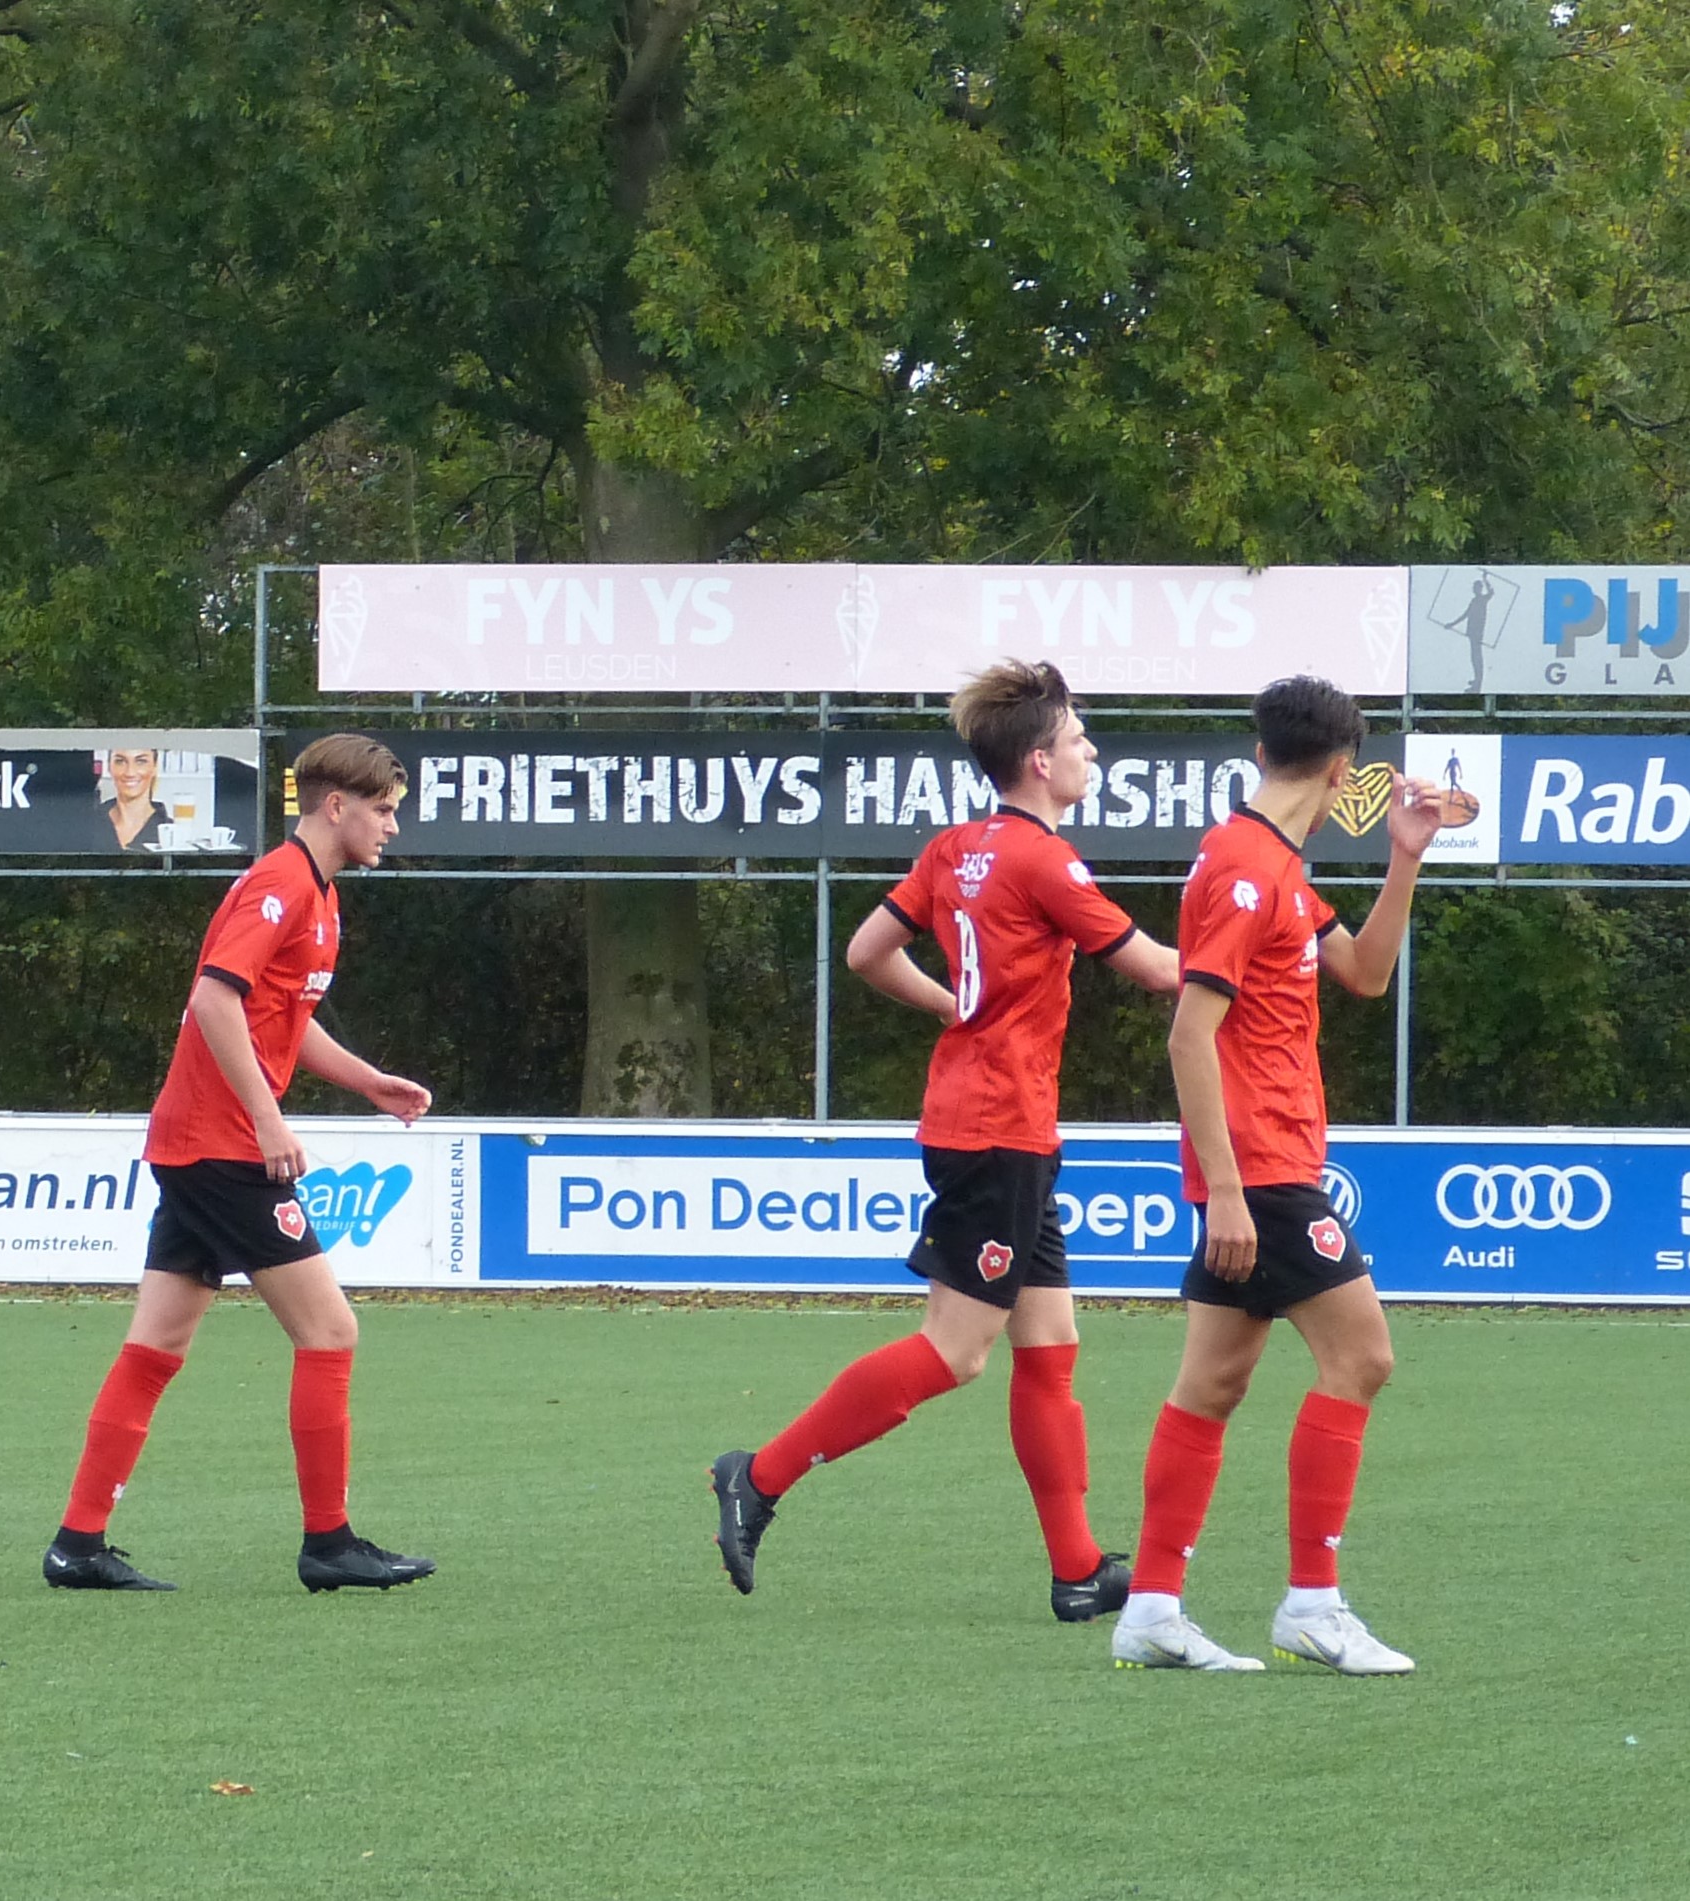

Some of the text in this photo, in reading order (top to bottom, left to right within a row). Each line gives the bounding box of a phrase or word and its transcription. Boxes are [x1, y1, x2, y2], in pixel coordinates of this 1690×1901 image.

[467, 577, 734, 645] FYN YS
[982, 579, 1255, 648] FYN YS
[525, 653, 677, 682] LEUSDEN
[1061, 655, 1196, 684] EUSDEN
[418, 754, 1262, 829] FRIETHUYS HAMRSHO
[311, 1221, 357, 1231] EDRIJF
[450, 1137, 465, 1274] PONDEALER.NL
[559, 1176, 1177, 1250] Pon Dealer oep
[12, 1234, 118, 1252] omstreken.
[1443, 1245, 1516, 1268] Audi
